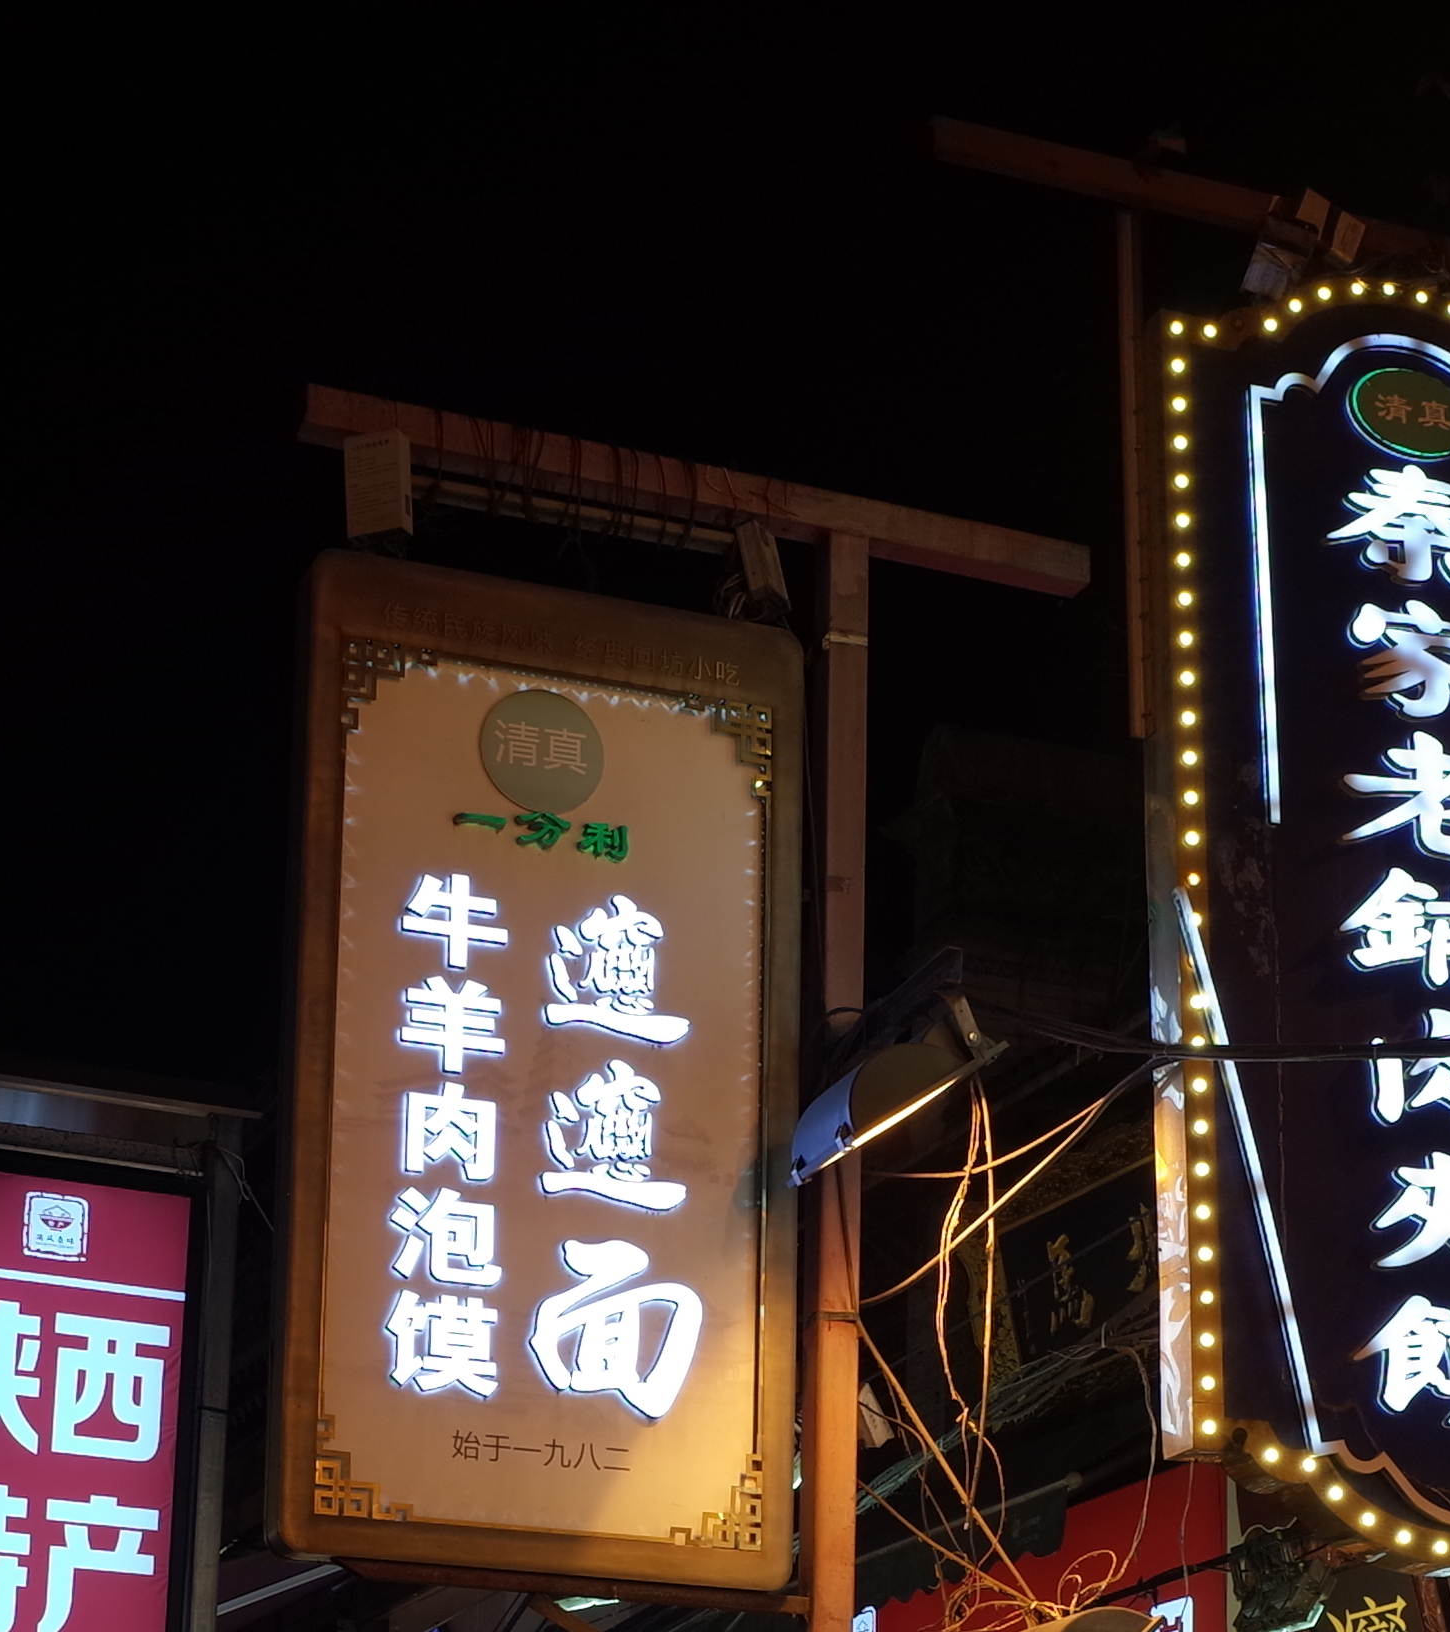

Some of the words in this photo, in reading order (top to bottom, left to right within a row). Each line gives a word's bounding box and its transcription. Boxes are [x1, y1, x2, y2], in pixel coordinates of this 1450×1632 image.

[382, 601, 555, 654] 传统民族风味
[574, 635, 742, 687] 经典回坊小吃
[494, 719, 588, 776] 清真
[453, 811, 631, 865] 一分利
[385, 873, 509, 1399] 牛羊肉泡馍
[451, 1429, 631, 1474] 始于一九八二
